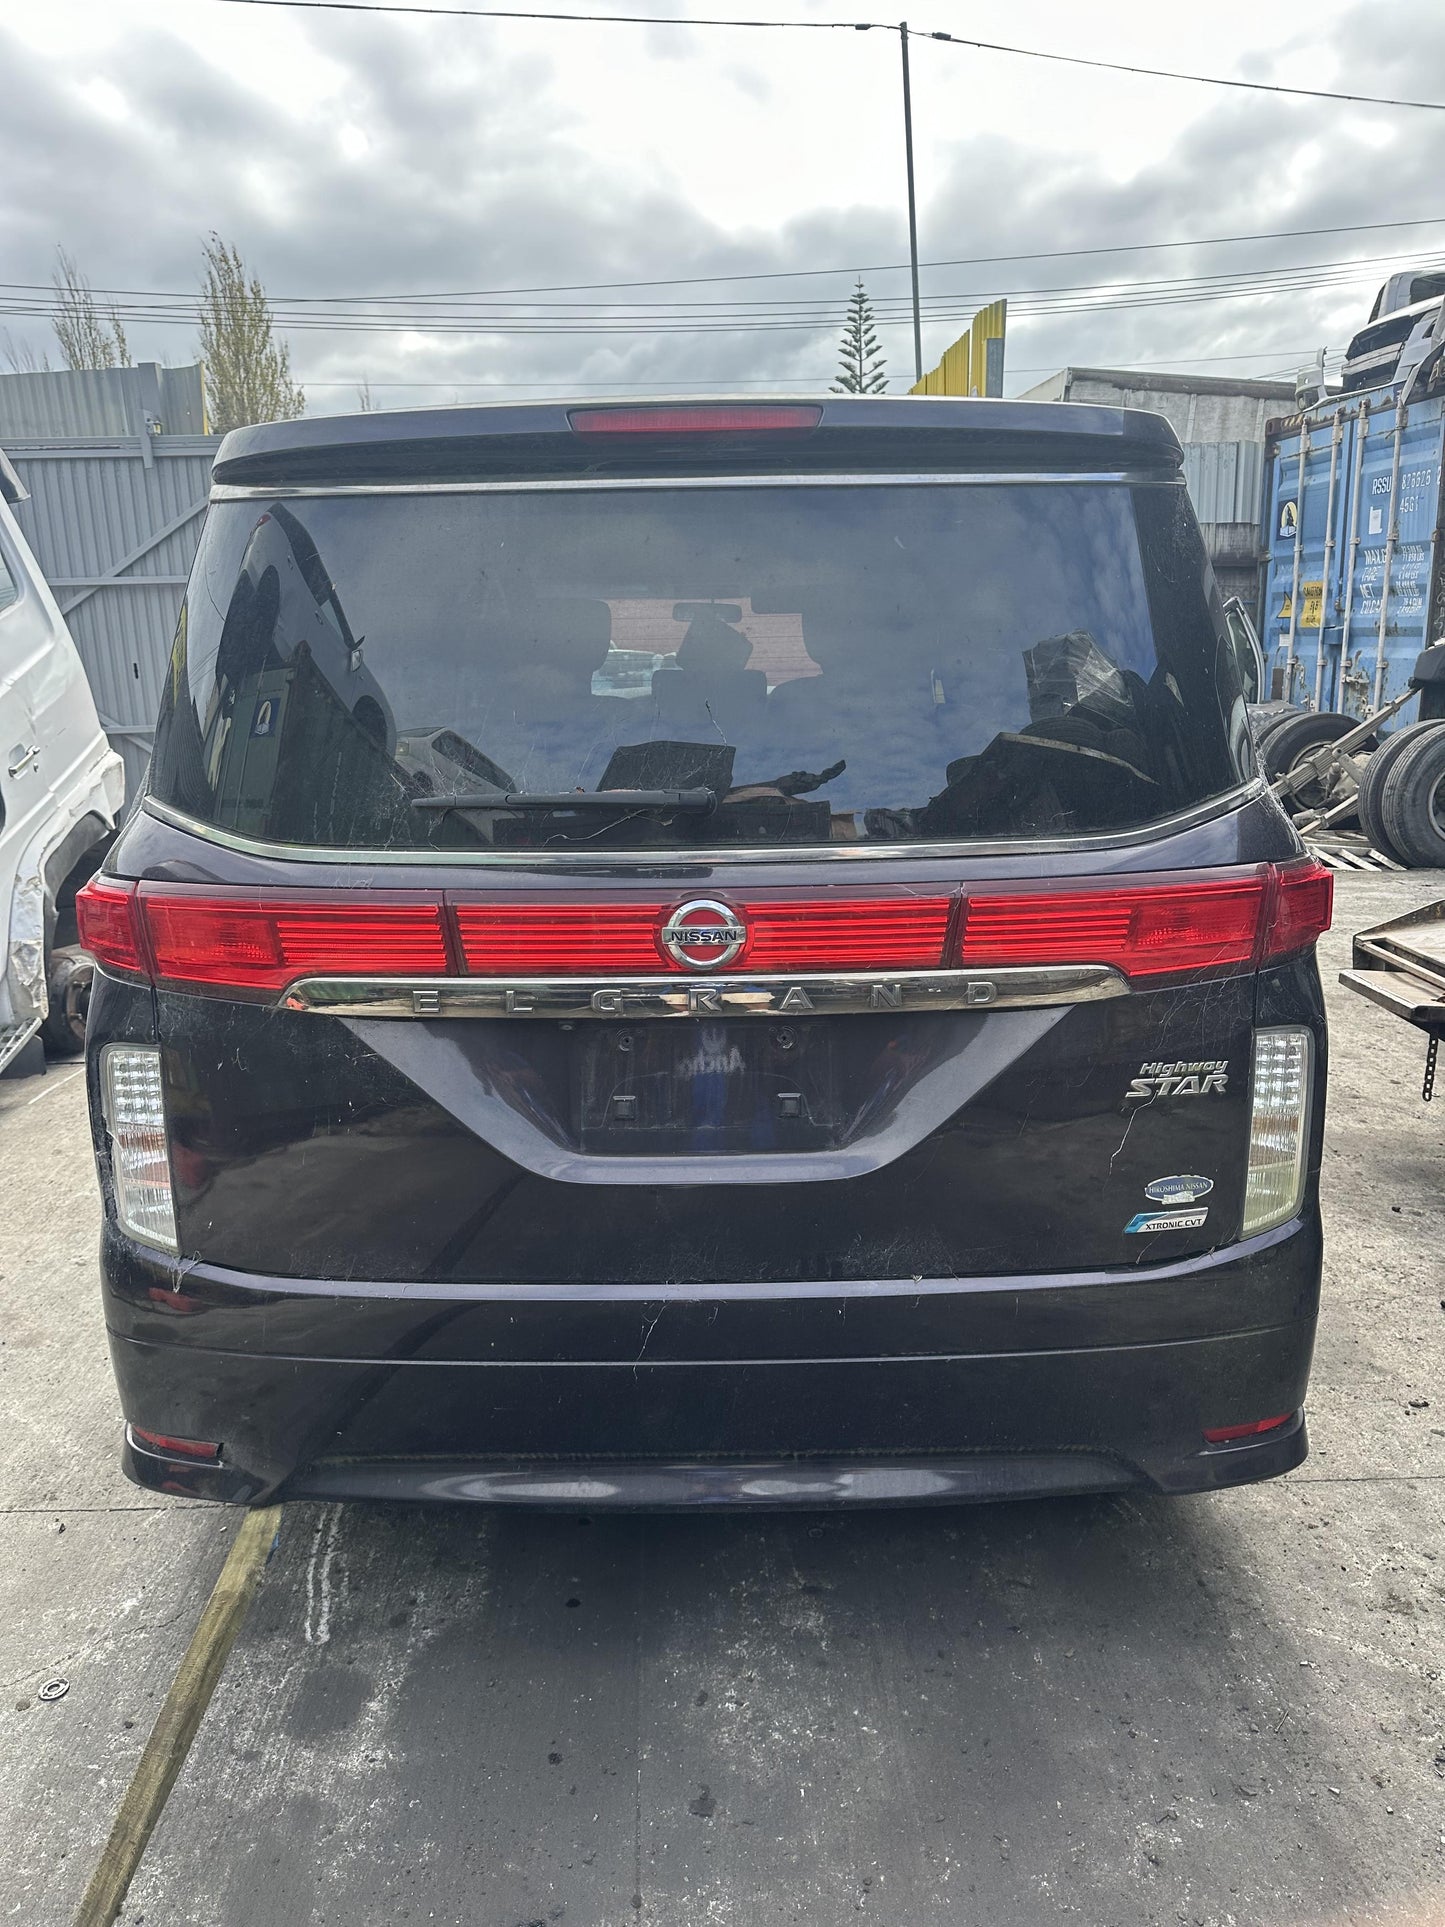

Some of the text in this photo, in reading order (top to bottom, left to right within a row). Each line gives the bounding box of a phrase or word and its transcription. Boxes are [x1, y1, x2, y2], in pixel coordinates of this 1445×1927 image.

[1360, 583, 1374, 598] NET
[671, 931, 737, 942] NISSAN
[412, 981, 999, 1014] ELGRAND
[1140, 1061, 1228, 1077] Highway
[1125, 1074, 1228, 1098] STAR
[1149, 1181, 1208, 1193] HIROSHIMA NISSAN
[1145, 1218, 1202, 1231] XTRONIC CVT
